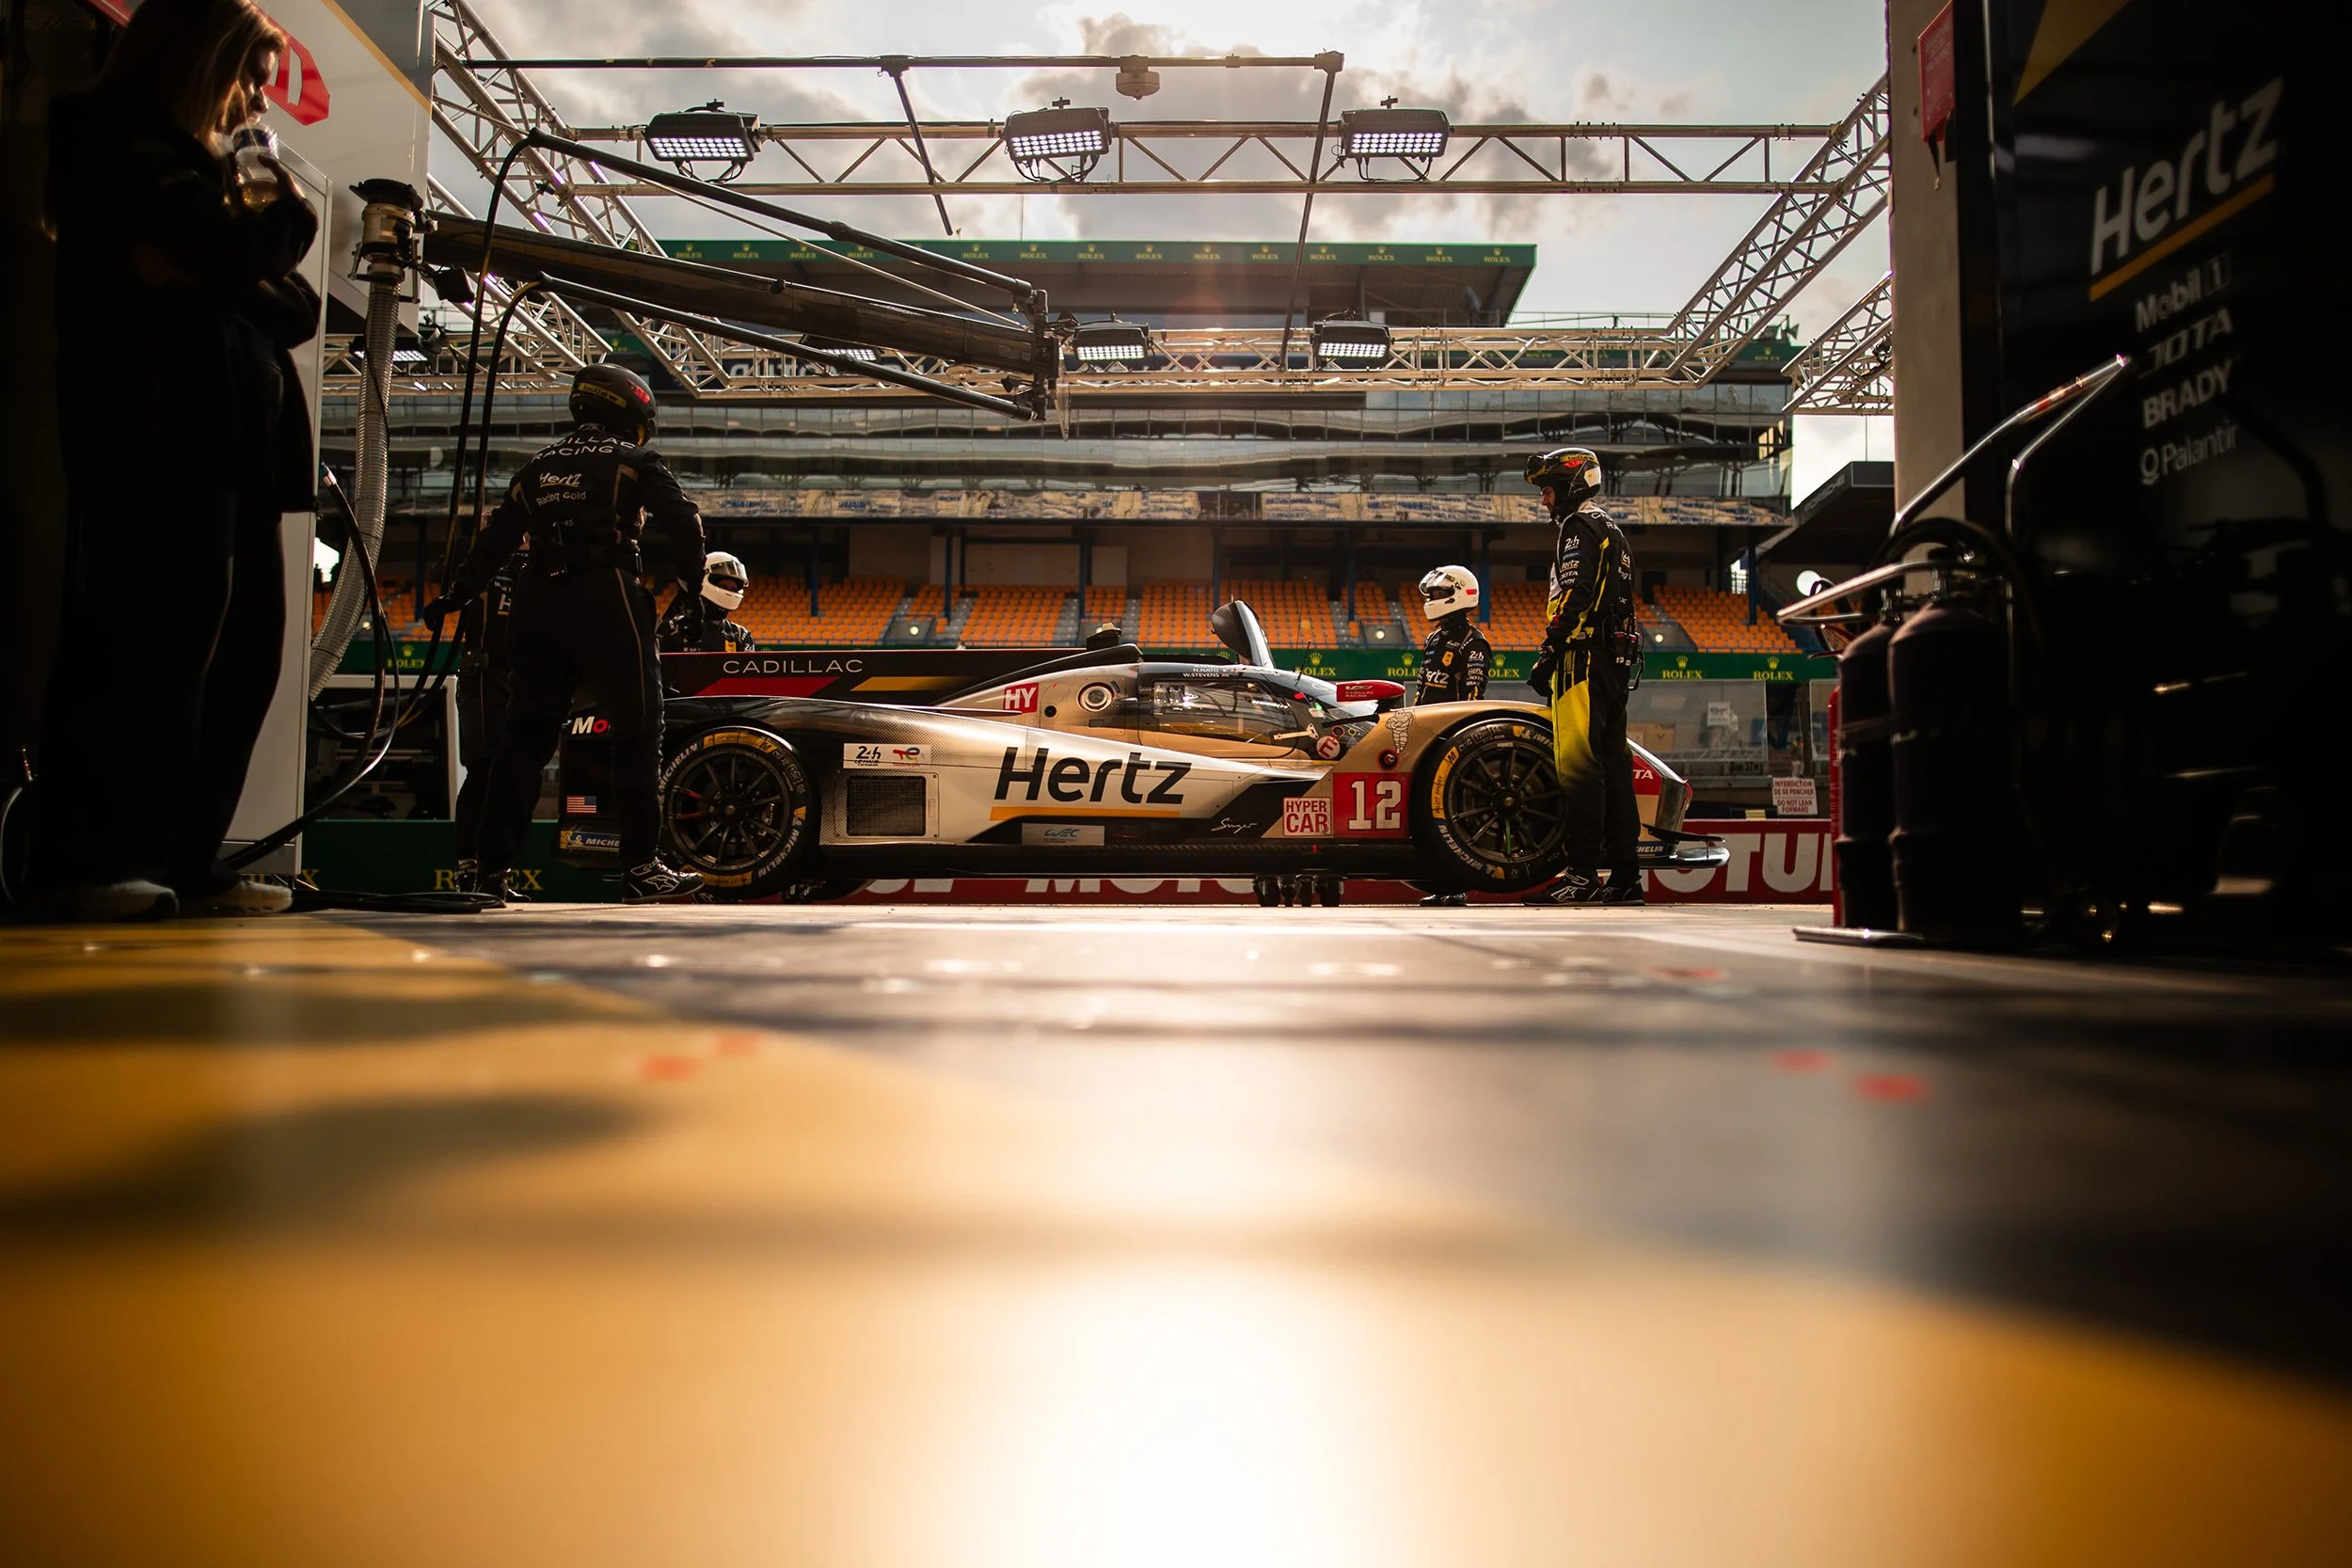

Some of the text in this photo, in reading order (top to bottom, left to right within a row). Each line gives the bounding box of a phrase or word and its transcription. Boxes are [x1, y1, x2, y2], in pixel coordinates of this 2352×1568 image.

[2090, 74, 2284, 277] Hertz
[2136, 267, 2202, 333] Mobil
[2137, 308, 2233, 379] JOTA
[2143, 358, 2233, 429] BRADY
[532, 446, 614, 464] RACING
[2161, 417, 2239, 476] Palantir
[539, 471, 582, 485] Hertz
[536, 490, 587, 507] Racing Gold
[723, 659, 863, 673] CADILLAC
[1661, 669, 1703, 679] ROLEX
[1753, 671, 1794, 681] ROLEX
[1005, 687, 1038, 710] HY
[659, 743, 698, 790] MICHELIN
[994, 747, 1191, 804] Hertz
[1286, 800, 1327, 813] HYPER
[1348, 780, 1403, 831] 12
[1044, 828, 1080, 837] WEC
[1285, 813, 1328, 833] CAR
[757, 829, 800, 878] MICHELIN
[1438, 825, 1484, 871] MICHELIN
